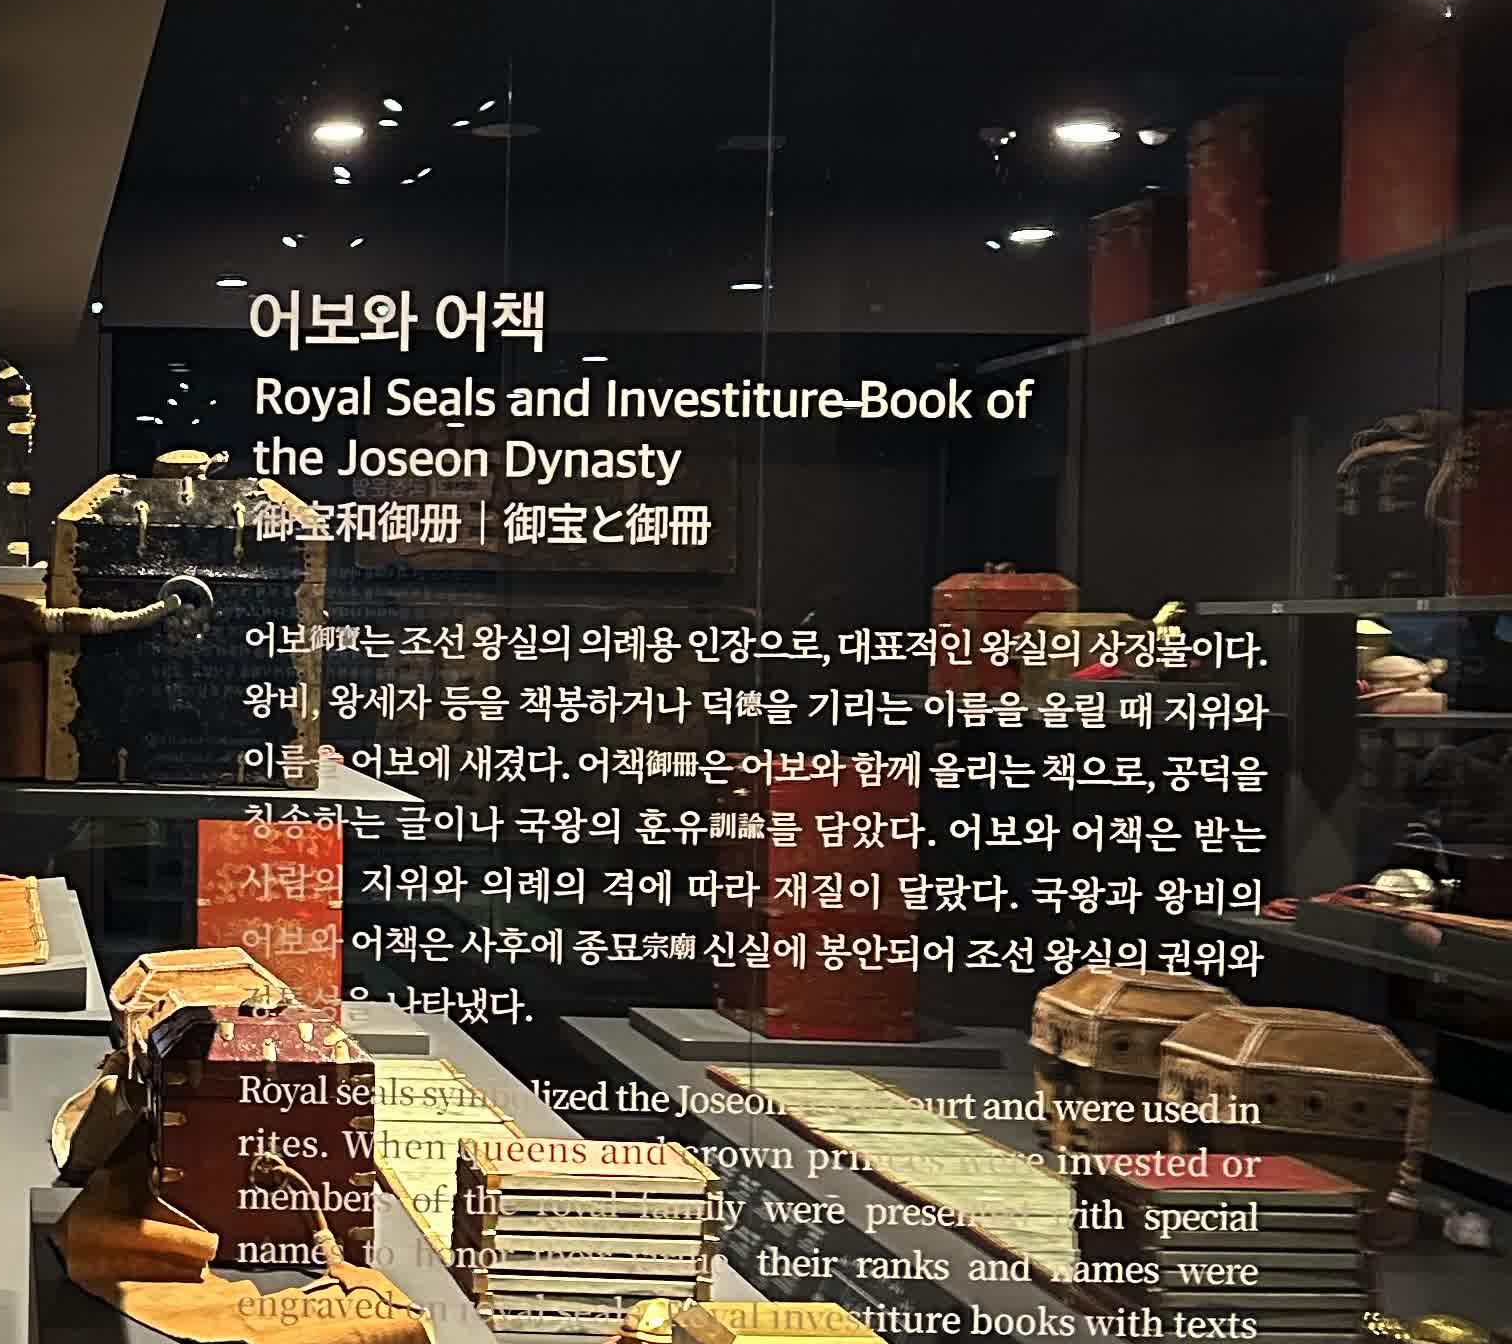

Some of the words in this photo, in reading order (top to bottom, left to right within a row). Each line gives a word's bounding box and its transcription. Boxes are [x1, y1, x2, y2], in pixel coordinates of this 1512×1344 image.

[249, 289, 419, 352] 어보와
[435, 290, 544, 353] 어책
[256, 375, 371, 423] Royal
[386, 376, 496, 417] Seals
[507, 377, 590, 418] and
[607, 377, 972, 419] Investiture-Book
[986, 378, 1035, 419] of
[252, 437, 325, 478] the
[337, 439, 488, 477] Joseon
[505, 440, 682, 486] Dynasty
[399, 623, 466, 660] 조선
[472, 623, 570, 662] 왕실의
[578, 624, 682, 664] 의례용
[688, 625, 831, 668] 인장으로,
[838, 627, 973, 667] 대표적인
[979, 624, 1080, 668] 왕실의
[1088, 626, 1267, 669] 상징물이다.
[242, 681, 320, 721] 왕비,
[328, 682, 433, 721] 왕세자
[439, 685, 510, 722] 등을
[519, 684, 692, 724] 책봉하거나
[808, 688, 913, 727] 기리는
[924, 689, 1029, 728] 이름을
[1036, 691, 1107, 729] 올릴
[1119, 692, 1153, 730] 때
[1164, 692, 1270, 732] 지위와
[245, 742, 346, 783] 이름을
[351, 743, 450, 784] 어보에
[459, 744, 570, 783] 새겼다.
[741, 749, 847, 787] 어보와
[851, 750, 921, 789] 함께
[928, 751, 1036, 790] 올리는
[1042, 752, 1156, 794] 책으로,
[1162, 754, 1268, 793] 공덕을
[242, 804, 385, 842] 칭송하는
[395, 804, 505, 843] 글이나
[514, 806, 620, 845] 국왕의
[814, 810, 936, 850] 담았다.
[949, 812, 1061, 852] 어보와
[1072, 814, 1182, 854] 어책은
[1194, 816, 1267, 853] 받는
[243, 863, 343, 900] 사람의
[361, 864, 469, 903] 지위와
[480, 866, 585, 905] 의례의
[602, 868, 671, 907] 격에
[688, 869, 761, 908] 따라
[773, 871, 880, 911] 재질이
[898, 873, 1019, 913] 달랐다.
[1031, 875, 1143, 915] 국왕과
[1154, 877, 1261, 917] 왕비의
[242, 923, 344, 962] 어보와
[352, 924, 455, 963] 어책은
[460, 926, 563, 965] 사후에
[703, 930, 806, 970] 신실에
[815, 933, 954, 973] 봉안되어
[965, 936, 1035, 974] 조선
[1043, 937, 1148, 977] 왕실의
[1158, 939, 1265, 977] 권위와
[386, 987, 533, 1025] 나타냈다.
[239, 1074, 329, 1113] Royal
[337, 1079, 415, 1106] seals
[422, 1079, 609, 1115] symlized
[617, 1080, 671, 1113] the
[677, 1085, 786, 1118] Joseon
[902, 1093, 976, 1120] ourt
[982, 1086, 1050, 1121] and
[1052, 1099, 1135, 1123] were
[1142, 1094, 1227, 1124] used
[1230, 1094, 1261, 1124] in
[238, 1128, 327, 1158] rites.
[342, 1130, 445, 1160] When
[459, 1139, 587, 1170] queens
[601, 1136, 666, 1164] and
[682, 1144, 793, 1169] crown
[1058, 1147, 1208, 1177] invested
[1223, 1156, 1263, 1178] or
[238, 1182, 393, 1212] members
[413, 1184, 448, 1213] of
[464, 1185, 517, 1216] the
[764, 1201, 845, 1224] were
[1144, 1202, 1259, 1238] special
[238, 1241, 343, 1265] names
[363, 1241, 394, 1266] to
[756, 1245, 842, 1280] their
[853, 1249, 950, 1281] ranks
[968, 1253, 1032, 1282] and
[1051, 1261, 1160, 1284] names
[1176, 1263, 1260, 1285] were
[239, 1291, 393, 1325] engraved
[773, 1304, 961, 1334] investiture
[969, 1303, 1076, 1337] books
[1086, 1307, 1164, 1338] with
[1173, 1311, 1258, 1339] texts
